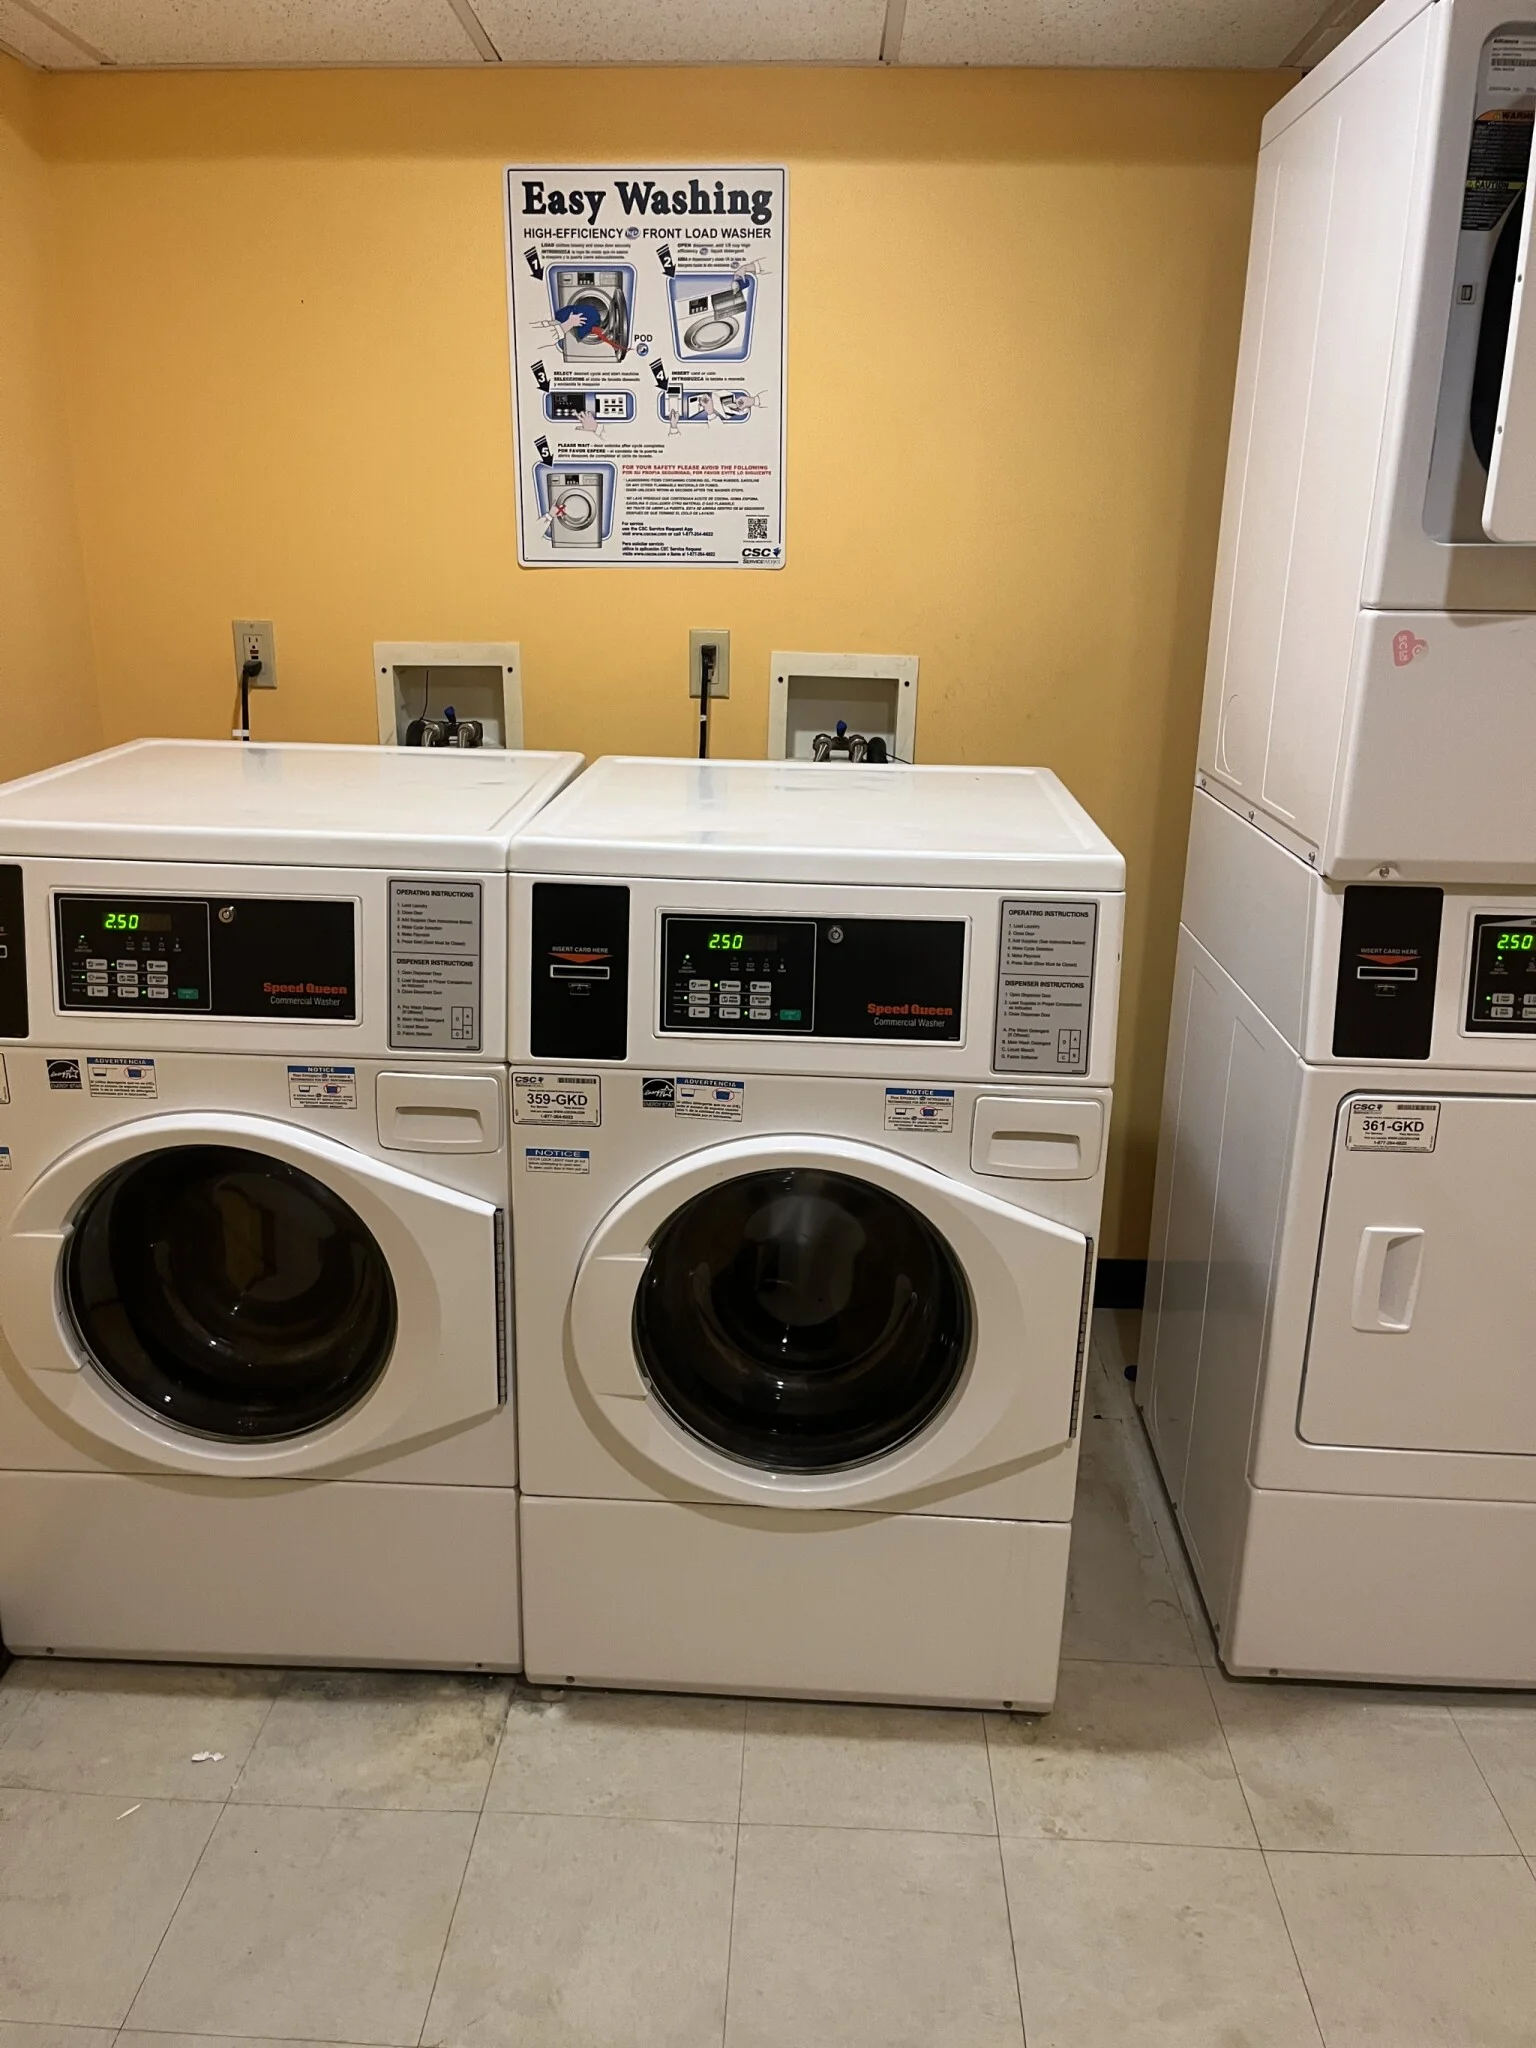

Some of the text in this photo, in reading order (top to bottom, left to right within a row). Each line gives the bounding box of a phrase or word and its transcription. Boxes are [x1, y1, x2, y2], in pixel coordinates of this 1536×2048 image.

[522, 180, 773, 225] Easy Washing
[523, 228, 623, 239] HIGH-EFFICIENCY
[643, 228, 683, 239] FRONT
[685, 228, 718, 239] LOAD
[720, 228, 772, 239] WASHER
[532, 260, 539, 271] 1
[664, 257, 672, 268] 2
[634, 334, 653, 342] POD
[538, 372, 545, 383] 3
[656, 370, 664, 381] 4
[541, 447, 549, 458] 5
[742, 548, 771, 557] CSC
[431, 890, 474, 898] INSTRUCTIONS
[1008, 909, 1089, 918] OPERATING INSTRUCTIONS
[105, 914, 139, 929] 2.50
[709, 934, 743, 949] 2.50
[1496, 934, 1533, 950] 2.50
[396, 958, 474, 967] DISPENSER INSTRUCTIONS
[263, 982, 348, 995] Speed Queen
[1039, 981, 1084, 989] INSTRUCTIONS
[270, 996, 341, 1006] Commercial Washer
[867, 1003, 953, 1016] Speed Queen
[873, 1017, 946, 1027] Commercial Washer
[684, 1078, 737, 1087] ADVERTENCIA
[526, 1093, 588, 1106] 359-GKD
[1362, 1120, 1424, 1132] 361-GKD
[534, 1149, 580, 1157] NOTICE
